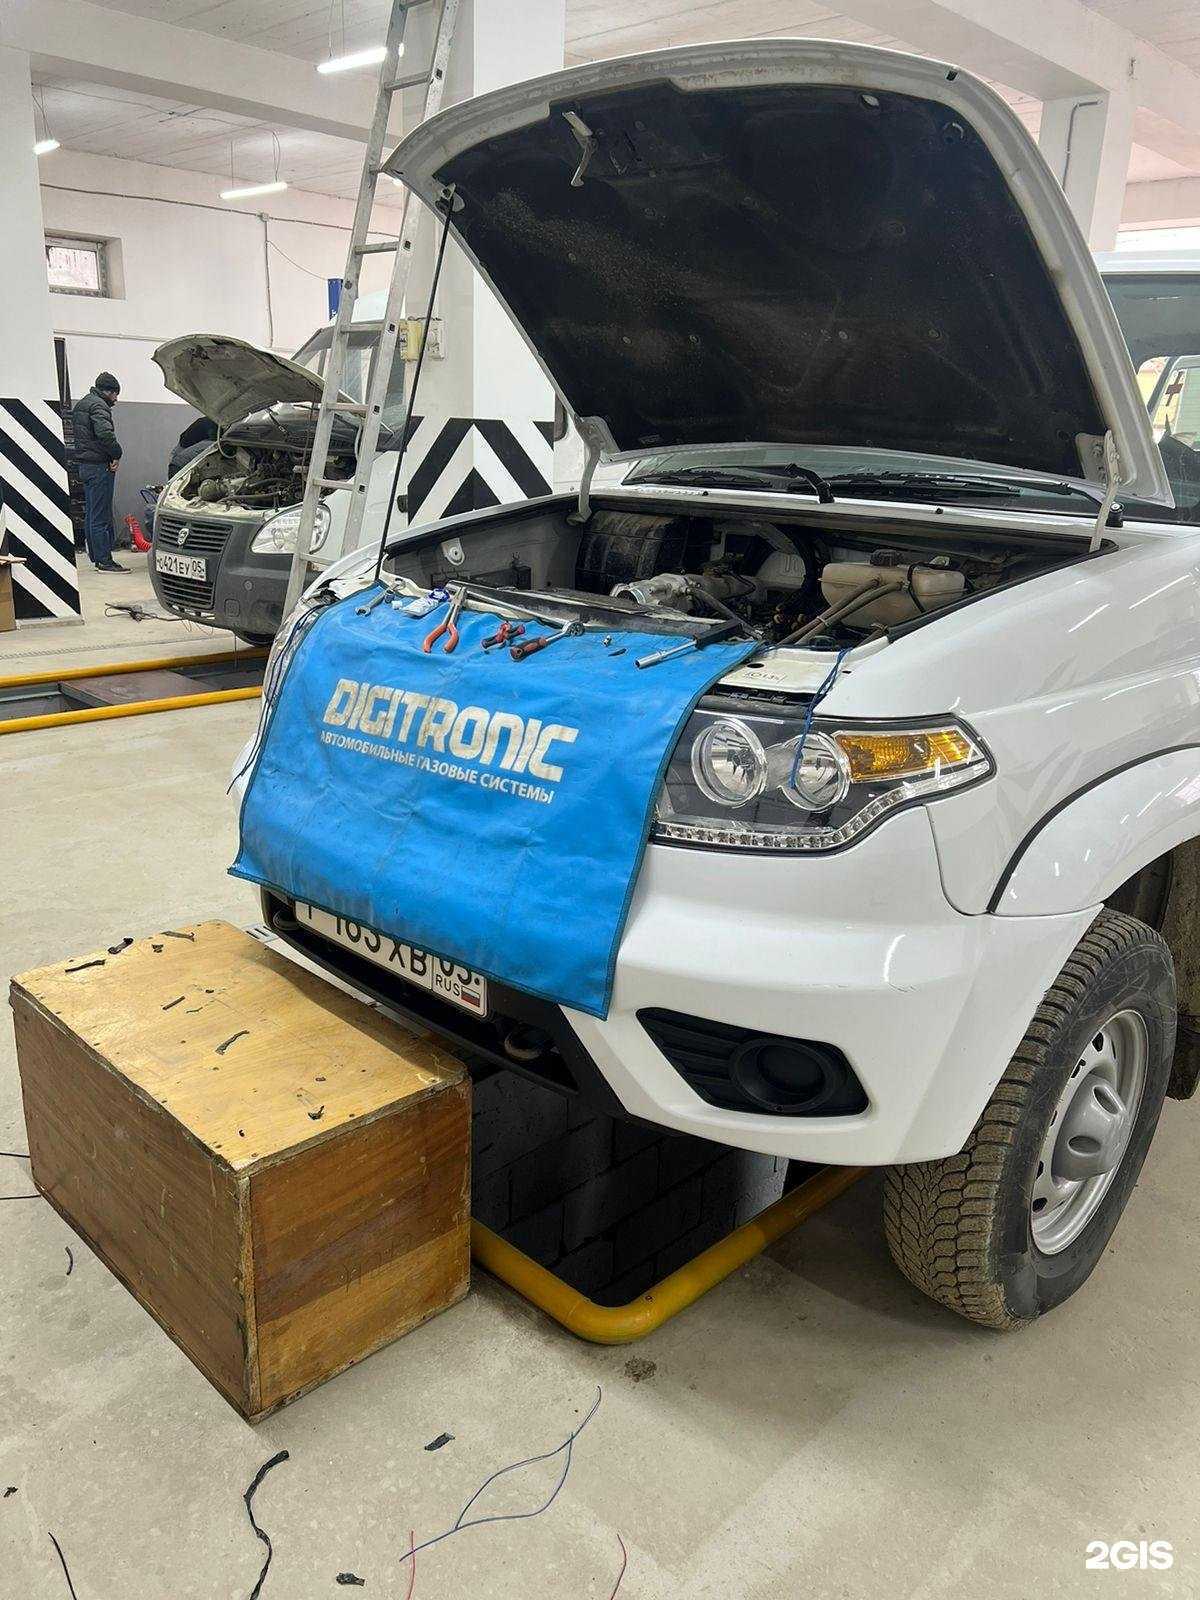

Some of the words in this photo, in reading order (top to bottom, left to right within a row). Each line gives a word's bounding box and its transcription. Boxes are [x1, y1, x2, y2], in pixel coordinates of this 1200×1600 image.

[320, 730, 416, 767] АВТОМОБИЛЬНЫЕ
[417, 755, 478, 784] ГАЗОВЫЕ
[480, 773, 554, 804] СИСТЕМЫ
[323, 679, 579, 782] DIGITRONIC
[435, 974, 460, 996] RUS
